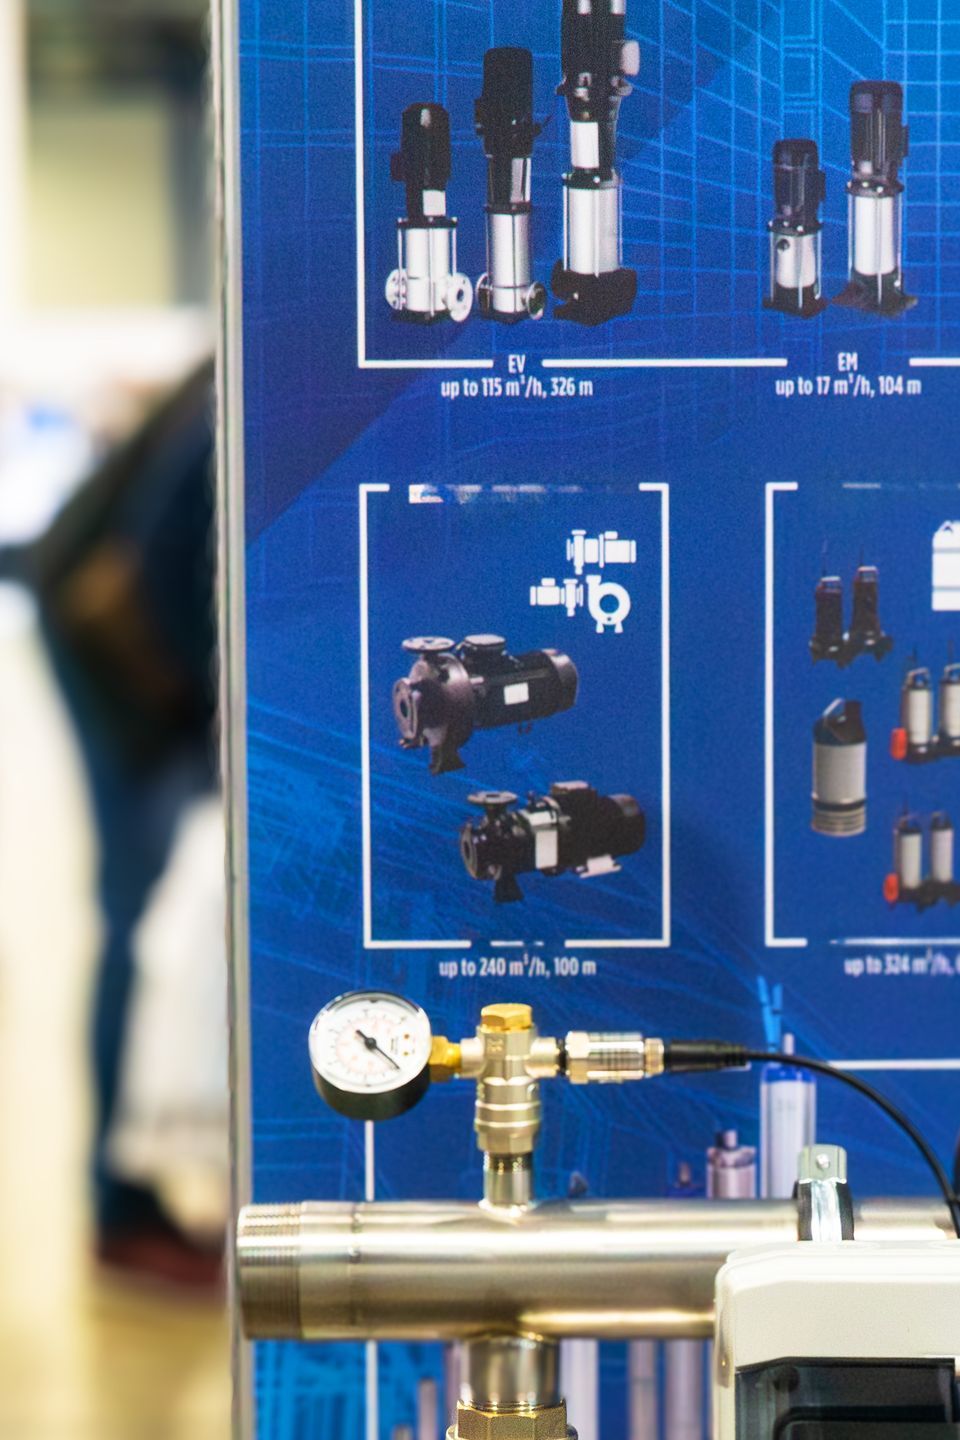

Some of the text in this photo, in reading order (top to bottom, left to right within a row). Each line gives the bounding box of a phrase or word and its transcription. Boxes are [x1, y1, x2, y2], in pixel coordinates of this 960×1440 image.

[508, 354, 526, 374] EV
[837, 352, 858, 372] EM
[441, 381, 460, 400] up
[463, 378, 479, 397] to
[481, 377, 503, 397] 115
[551, 377, 576, 397] 326
[579, 380, 594, 396] m
[775, 379, 795, 398] up
[798, 376, 813, 396] to
[816, 375, 831, 396] 17
[878, 375, 904, 396] 104
[906, 379, 922, 395] m
[439, 961, 458, 979] up
[461, 958, 477, 977] to
[479, 957, 506, 977] 240
[553, 957, 579, 977] 100
[581, 960, 597, 976] m
